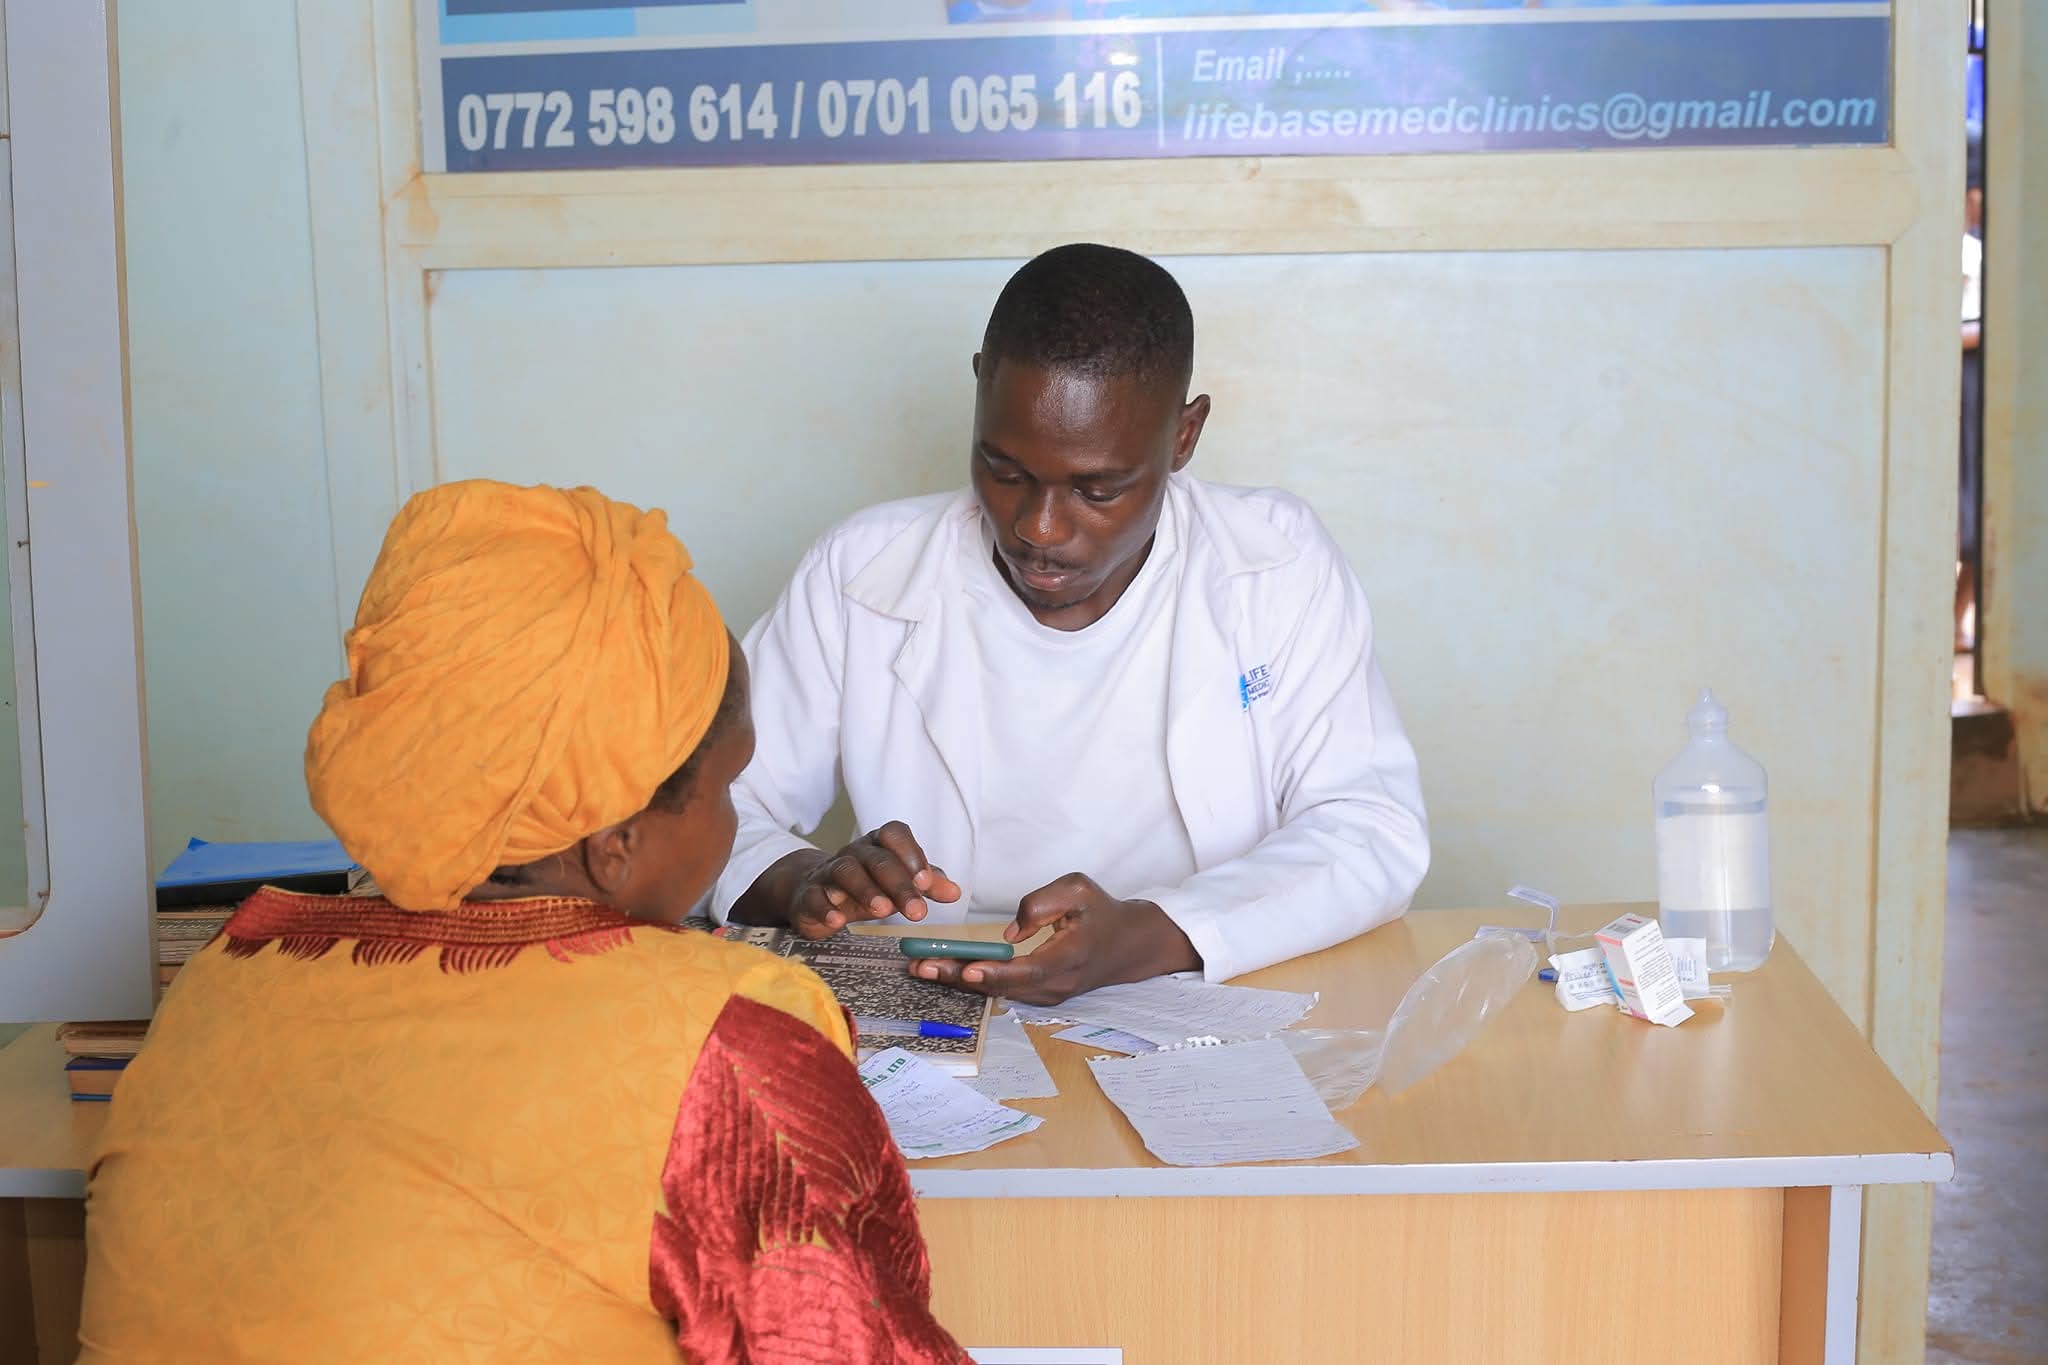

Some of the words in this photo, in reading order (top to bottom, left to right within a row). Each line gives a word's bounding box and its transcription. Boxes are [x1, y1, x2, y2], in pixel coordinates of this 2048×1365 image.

[1192, 47, 1285, 82] Email
[457, 90, 575, 150] 0772
[588, 86, 676, 146] 598
[688, 76, 778, 142] 614
[790, 80, 805, 139] /
[817, 77, 931, 138] 0701
[949, 73, 1039, 134] 065
[1053, 71, 1143, 129] 116
[1183, 90, 1878, 140] lifebasemedclinics@gmail.com
[887, 1057, 906, 1073] LTD
